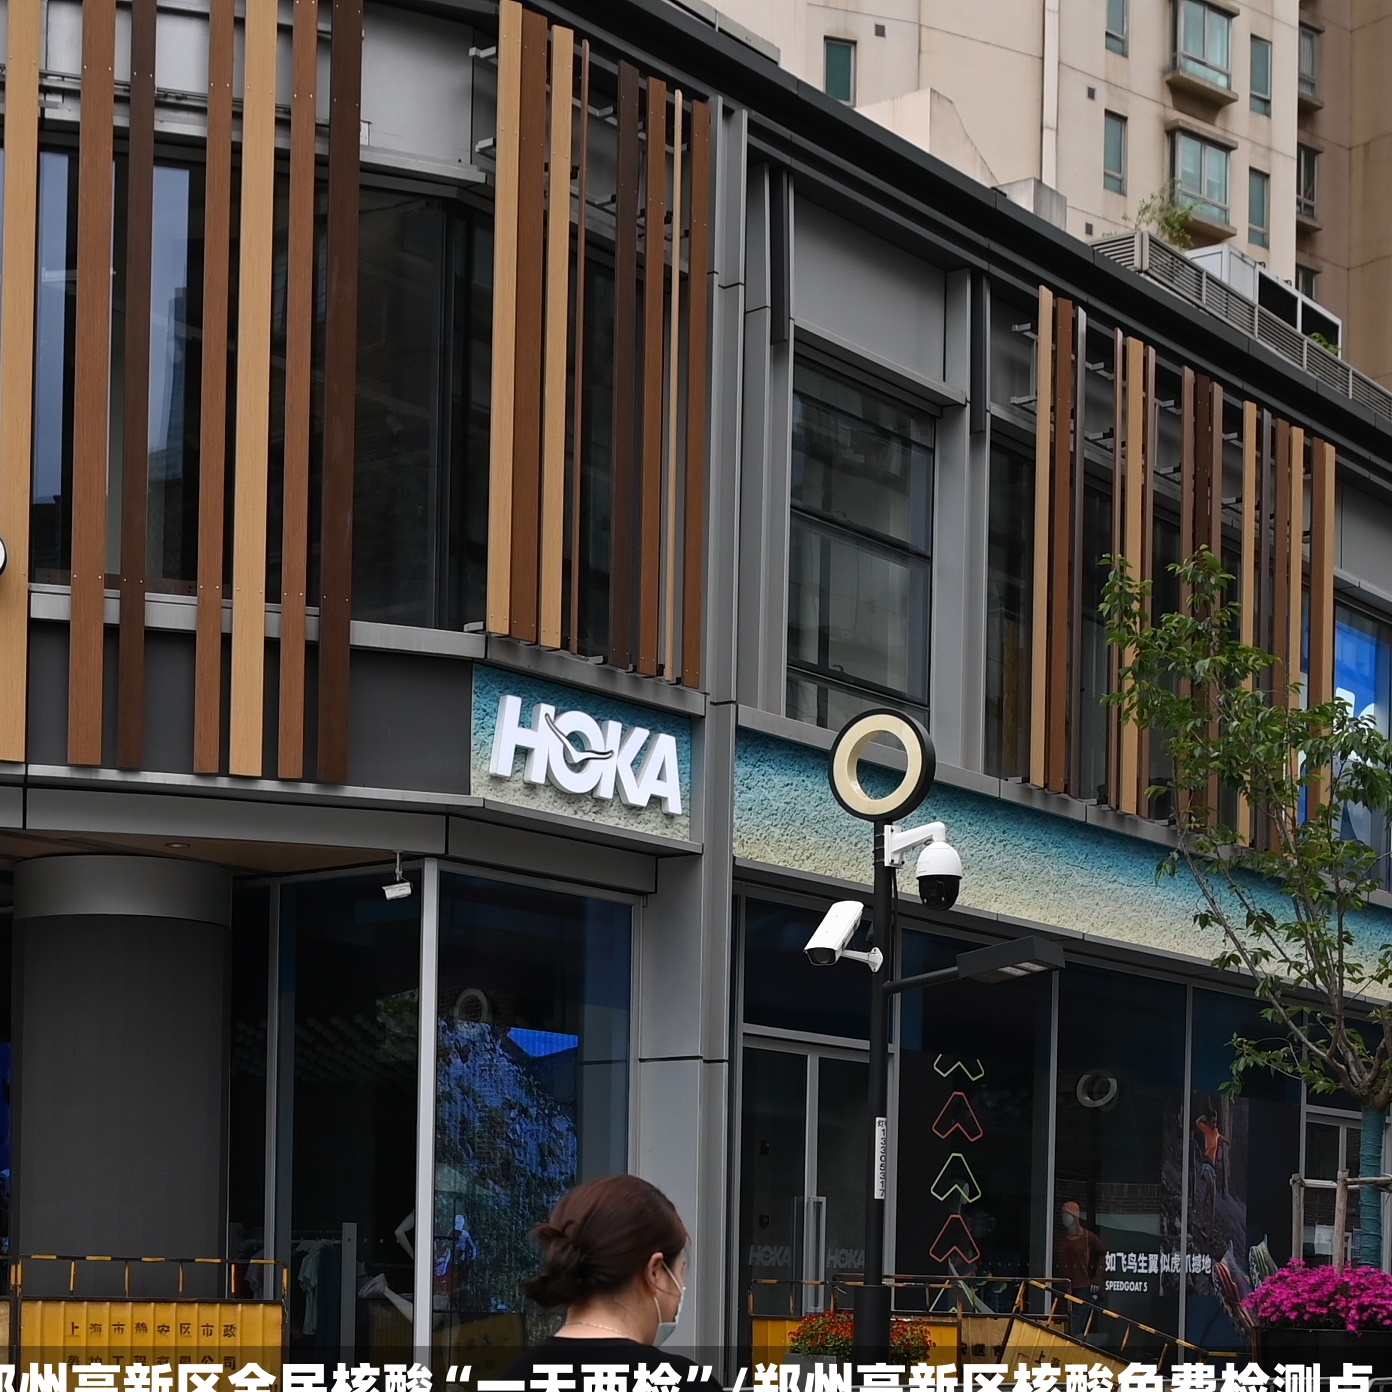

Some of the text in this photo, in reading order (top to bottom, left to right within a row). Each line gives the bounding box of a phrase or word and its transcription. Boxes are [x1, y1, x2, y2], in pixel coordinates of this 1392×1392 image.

[489, 695, 682, 815] HOKA
[748, 1244, 792, 1268] HOKA
[1105, 1280, 1143, 1292] SPEEDGOAT
[67, 1320, 238, 1338] 上海市静安区市政
